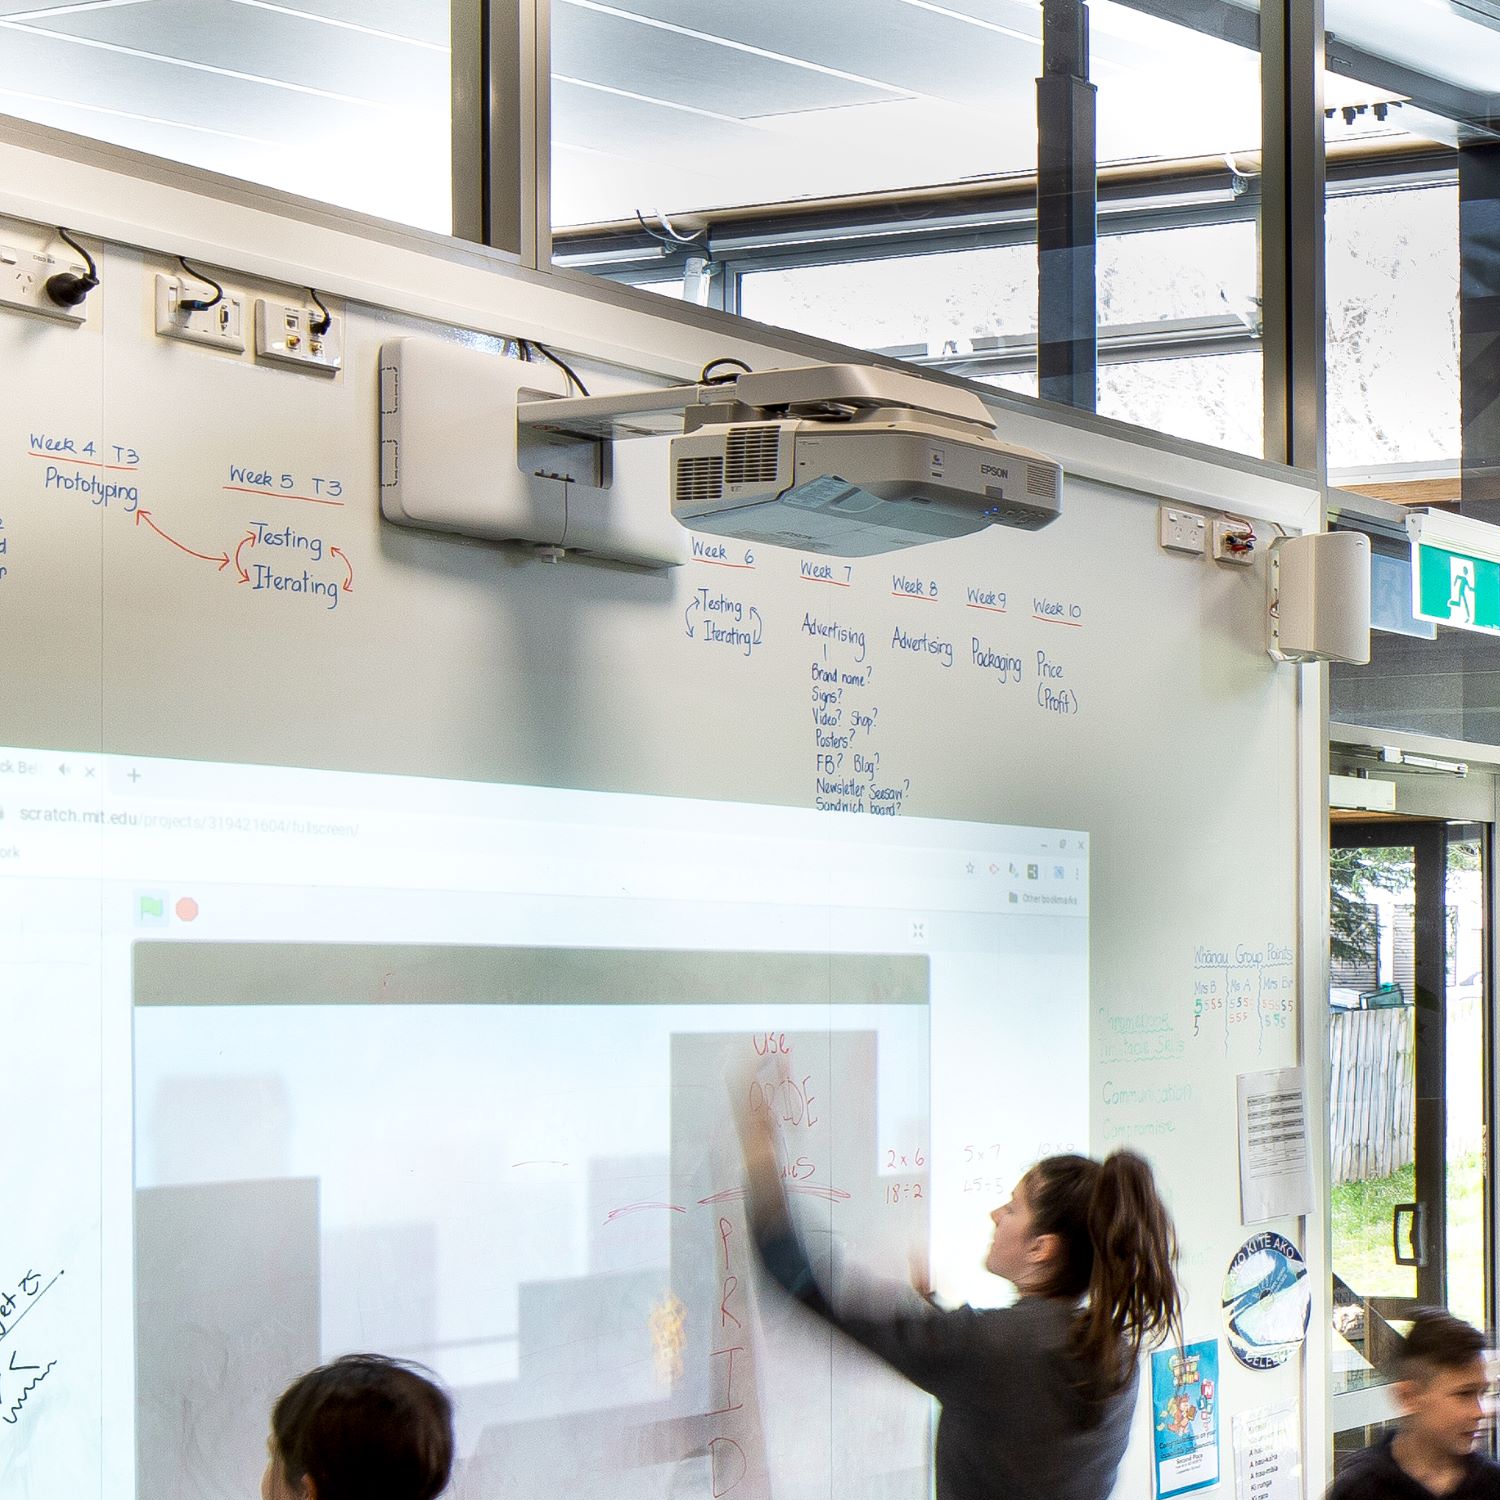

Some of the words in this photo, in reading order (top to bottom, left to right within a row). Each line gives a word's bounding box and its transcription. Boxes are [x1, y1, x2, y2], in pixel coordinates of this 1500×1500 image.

[30, 434, 77, 454] Week
[82, 441, 96, 456] 4
[112, 446, 139, 464] T3
[229, 465, 273, 486] Week
[280, 474, 294, 489] 5
[312, 478, 343, 496] T3
[981, 464, 1008, 479] EPSON
[45, 467, 138, 512] Prototyping
[250, 522, 322, 561] Testing
[691, 537, 727, 560] Week
[744, 549, 754, 564] 6
[800, 560, 833, 581] Week
[843, 566, 852, 582] 7
[252, 565, 338, 609] Iterating
[892, 575, 923, 594] Week
[929, 581, 938, 597] 8
[967, 587, 996, 605] Week
[998, 592, 1007, 608] 9
[697, 588, 743, 621] Testing
[1033, 598, 1064, 615] Week
[1069, 603, 1082, 618] 10
[703, 619, 752, 656] Iterating
[801, 613, 866, 662] Advertising
[892, 626, 953, 667] Advertising
[811, 662, 838, 683] Brand
[841, 666, 872, 687] name?
[972, 637, 1022, 684] Packaging
[1037, 650, 1063, 678] Price
[812, 686, 843, 711] Signs?
[1038, 682, 1078, 714] (Profit)
[812, 707, 842, 727] Video?
[851, 707, 878, 735] Shop?
[816, 728, 856, 749] Posters?
[816, 753, 844, 777] FB?
[854, 752, 880, 782] Blog?
[816, 778, 865, 797] Newsletter
[816, 797, 864, 814] Sandwich
[1235, 944, 1264, 969] Group
[1267, 943, 1294, 961] Points
[1273, 1239, 1295, 1260] AKO
